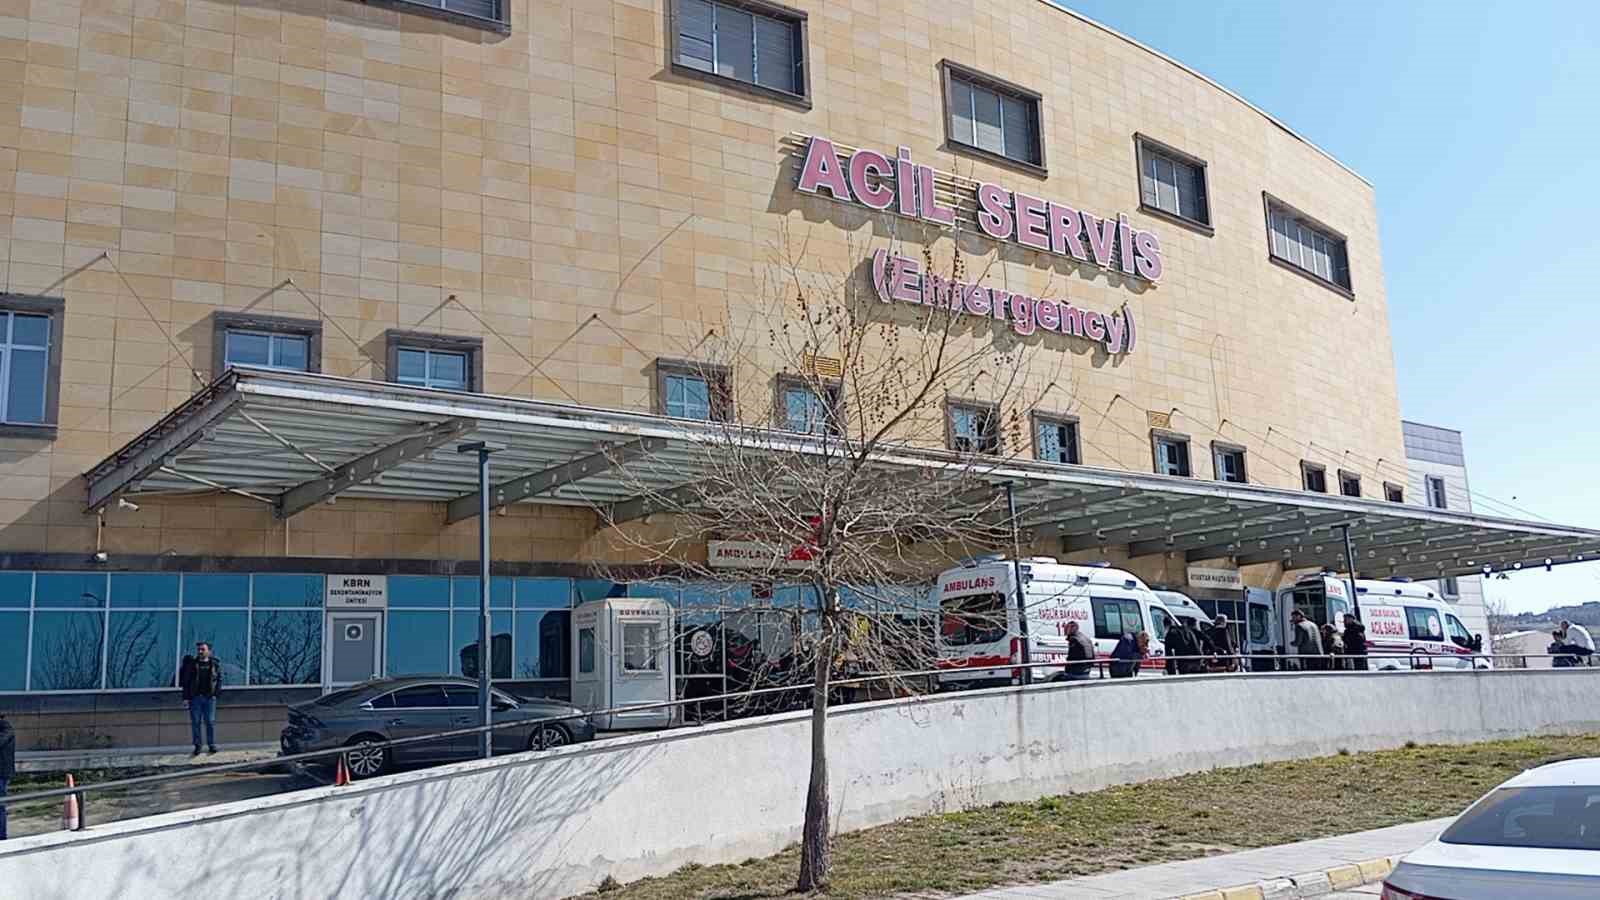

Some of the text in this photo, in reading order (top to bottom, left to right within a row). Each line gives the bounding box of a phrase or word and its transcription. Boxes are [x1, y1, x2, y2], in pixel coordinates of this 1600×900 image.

[799, 135, 1164, 283] ACİL SERVİS
[872, 248, 1137, 354] (Emergency)
[343, 578, 370, 588] KBRN
